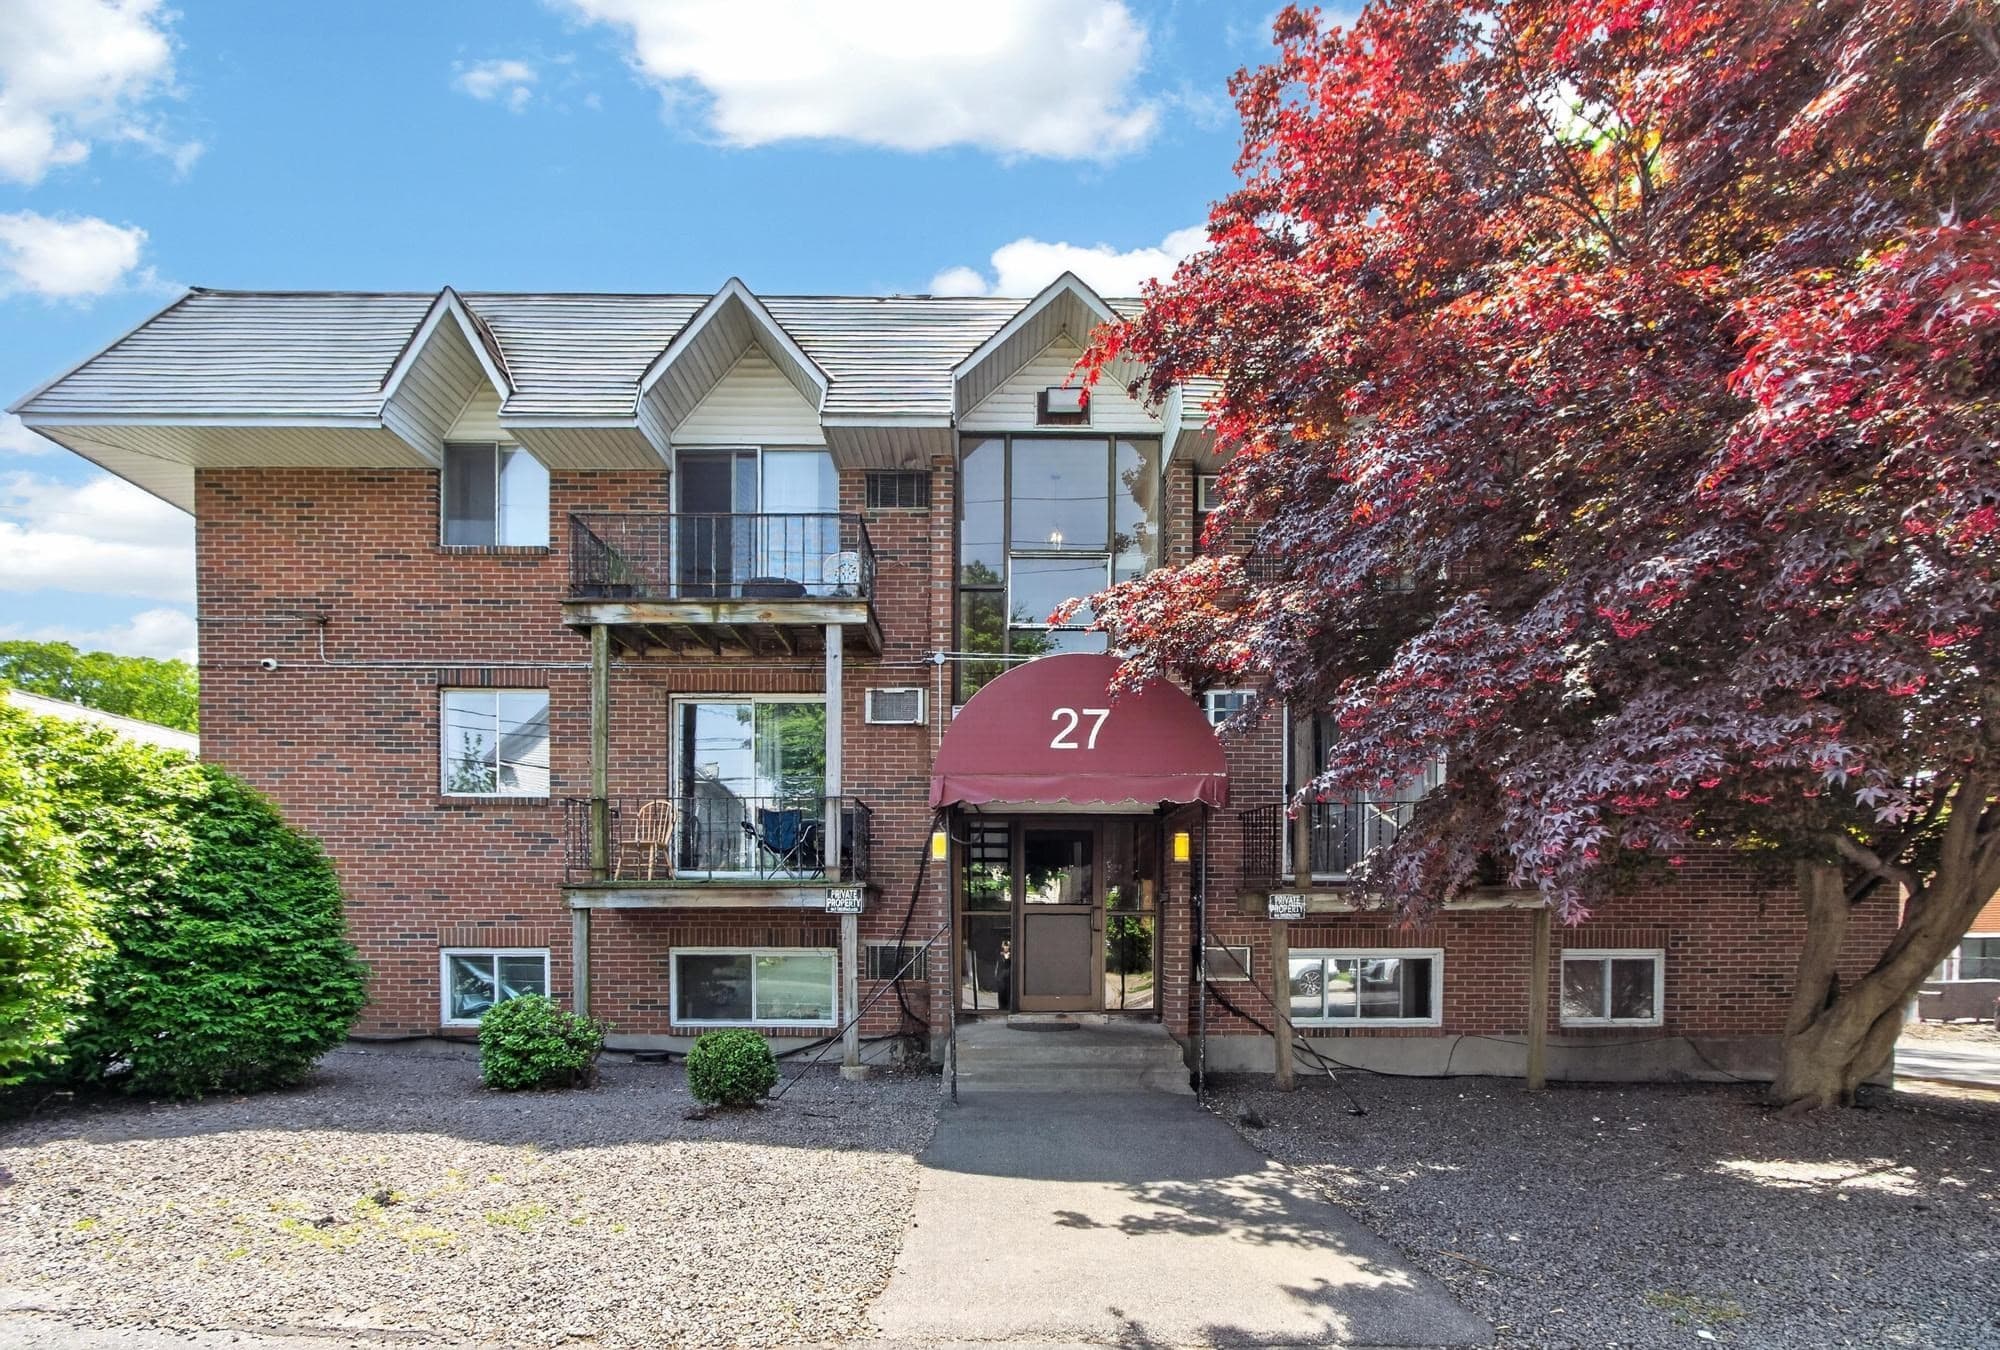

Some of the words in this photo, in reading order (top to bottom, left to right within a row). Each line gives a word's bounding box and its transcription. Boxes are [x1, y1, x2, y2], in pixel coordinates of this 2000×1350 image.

[1050, 708, 1110, 749] 27
[831, 889, 857, 898] PRIVATE
[827, 898, 861, 907] PROPERTY
[1275, 895, 1301, 905] PRIVATE
[1269, 904, 1304, 913] PROPERTY
